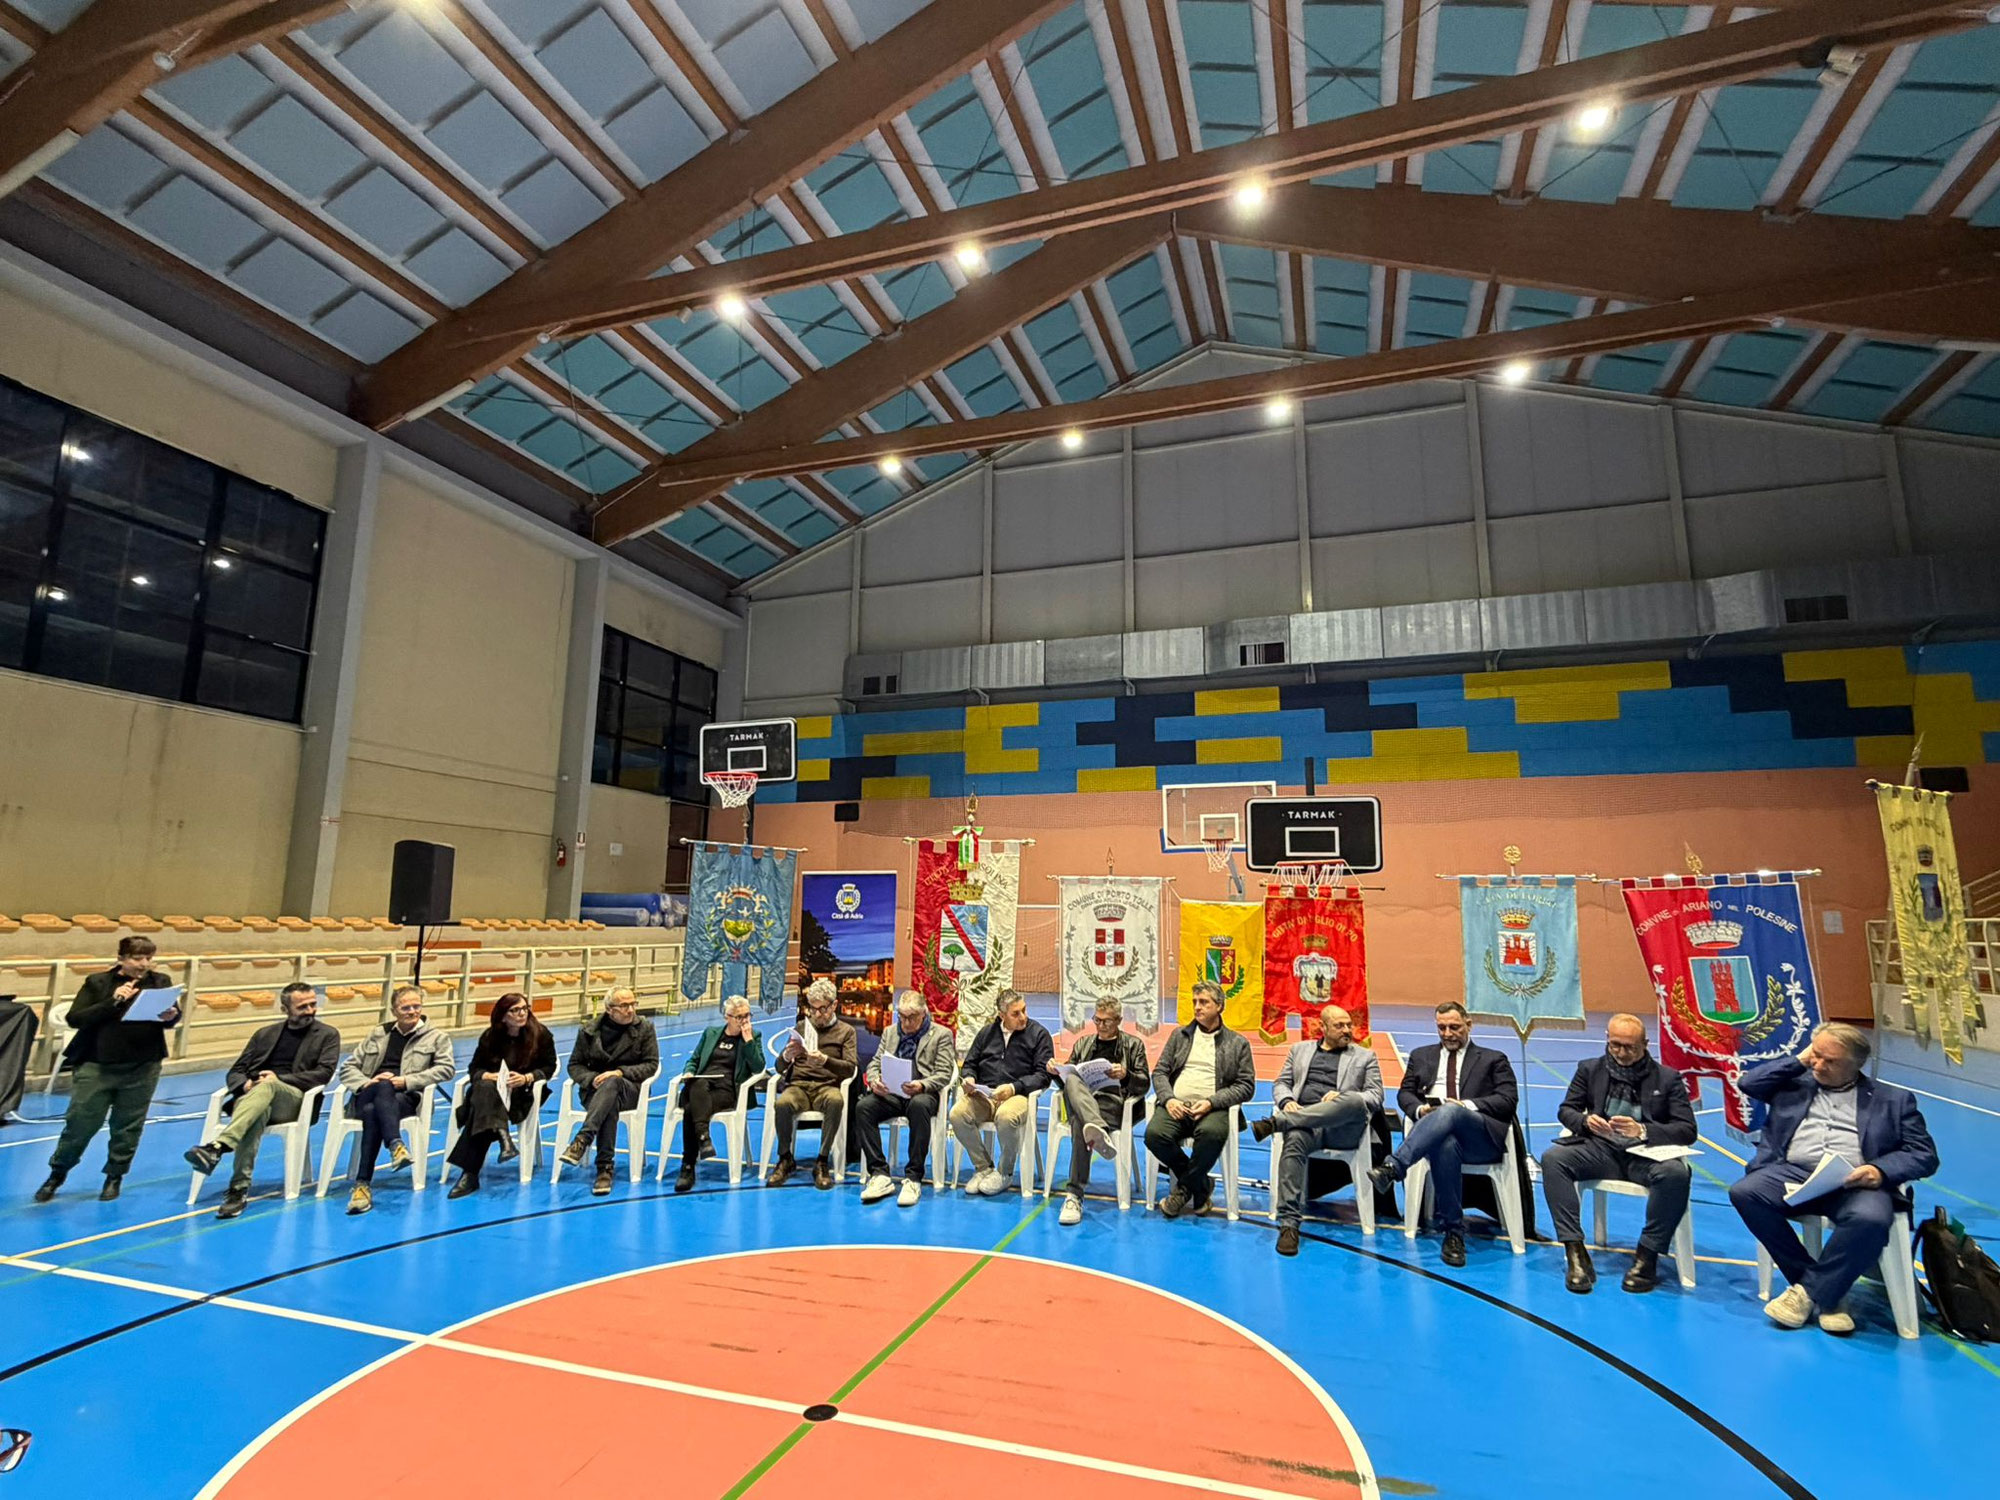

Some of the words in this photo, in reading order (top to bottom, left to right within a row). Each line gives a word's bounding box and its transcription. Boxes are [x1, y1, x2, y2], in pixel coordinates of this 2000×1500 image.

[729, 732, 764, 741] TARMAK
[1287, 810, 1336, 820] TARMAK
[1067, 892, 1095, 911] COMUNE
[1106, 889, 1131, 900] PORTO
[1133, 895, 1154, 912] TOLLE
[1682, 900, 1723, 913] ARIANO
[1745, 904, 1798, 934] POLESINE
